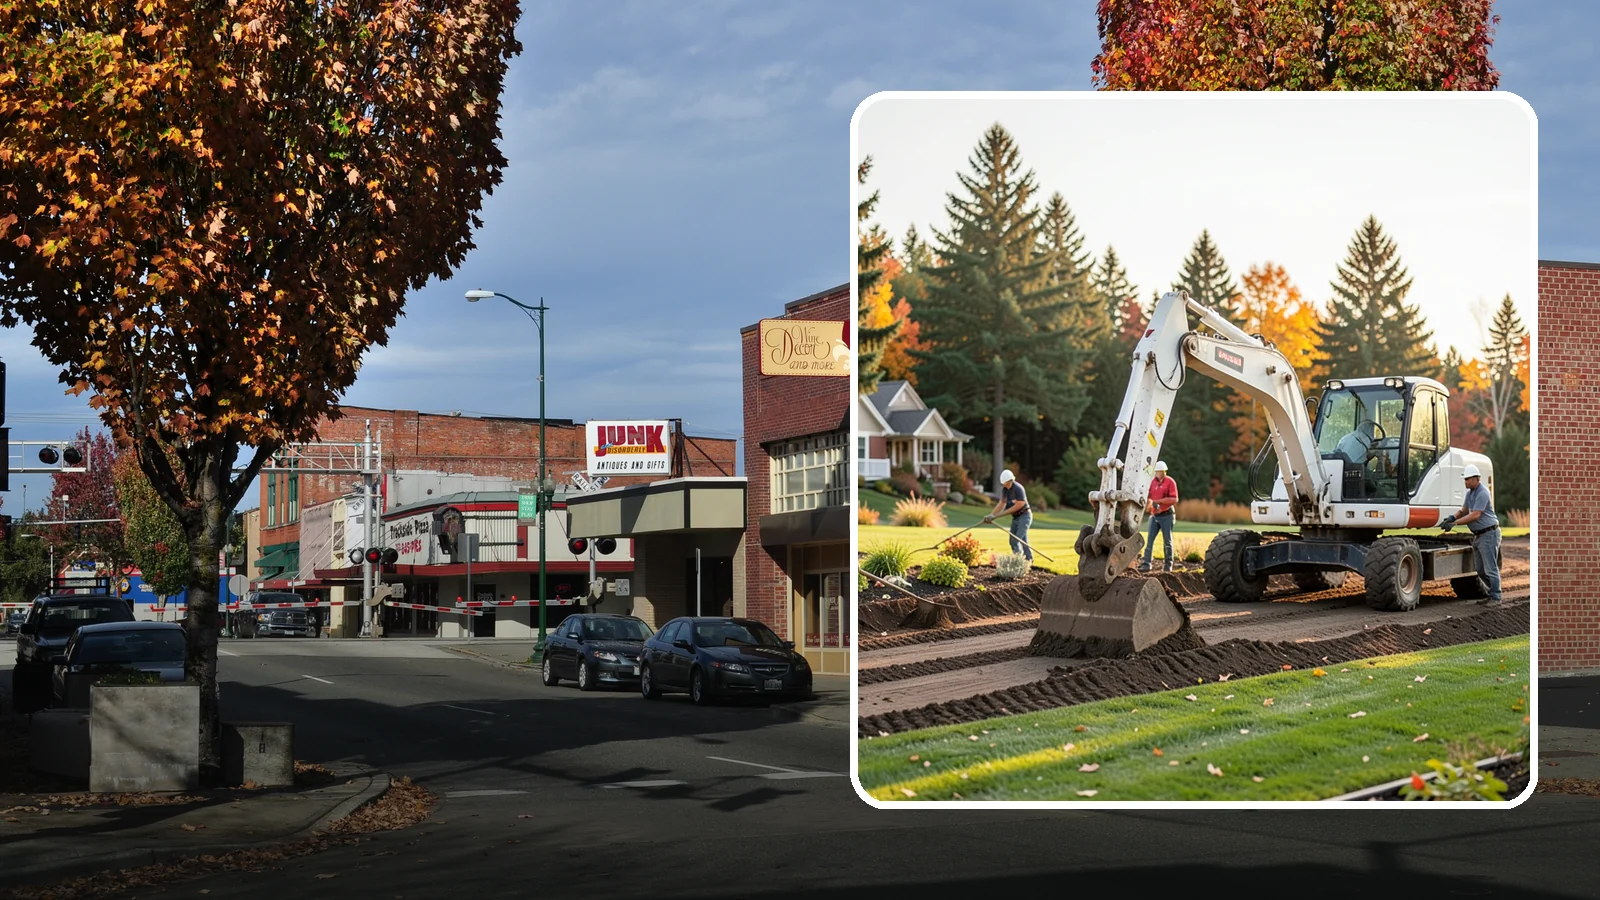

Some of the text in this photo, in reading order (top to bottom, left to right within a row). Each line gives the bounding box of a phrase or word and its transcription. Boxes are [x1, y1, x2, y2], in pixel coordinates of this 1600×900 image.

[595, 425, 665, 457] JUNK
[607, 446, 646, 454] DISORDERLY
[597, 460, 665, 470] ANTIQUES AND GIFTS
[390, 519, 429, 540] Trackside Pizza
